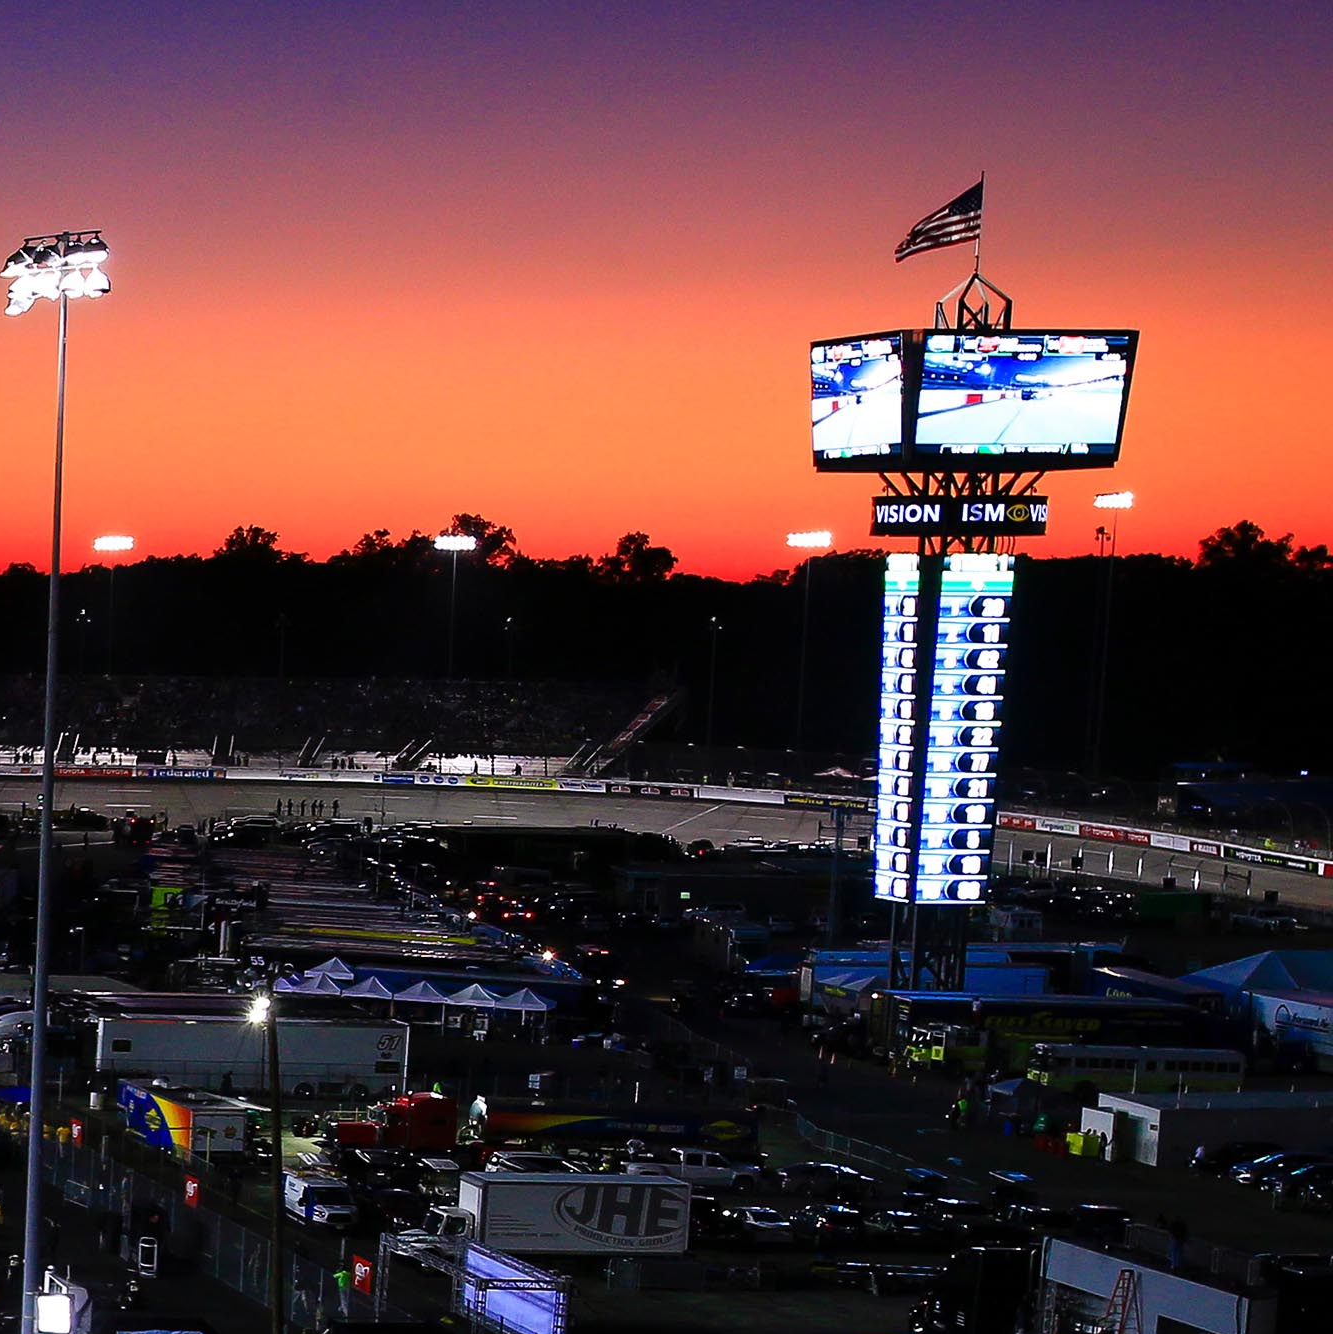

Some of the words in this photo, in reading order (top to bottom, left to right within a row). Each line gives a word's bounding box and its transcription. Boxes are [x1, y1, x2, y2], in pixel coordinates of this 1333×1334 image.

[876, 504, 940, 522] VISION
[962, 503, 1004, 521] ISM
[153, 768, 209, 778] Federated
[377, 1034, 402, 1051] 51
[563, 1184, 683, 1237] JHE
[574, 1226, 634, 1247] PRODUCTION
[639, 1233, 674, 1247] GROUP
